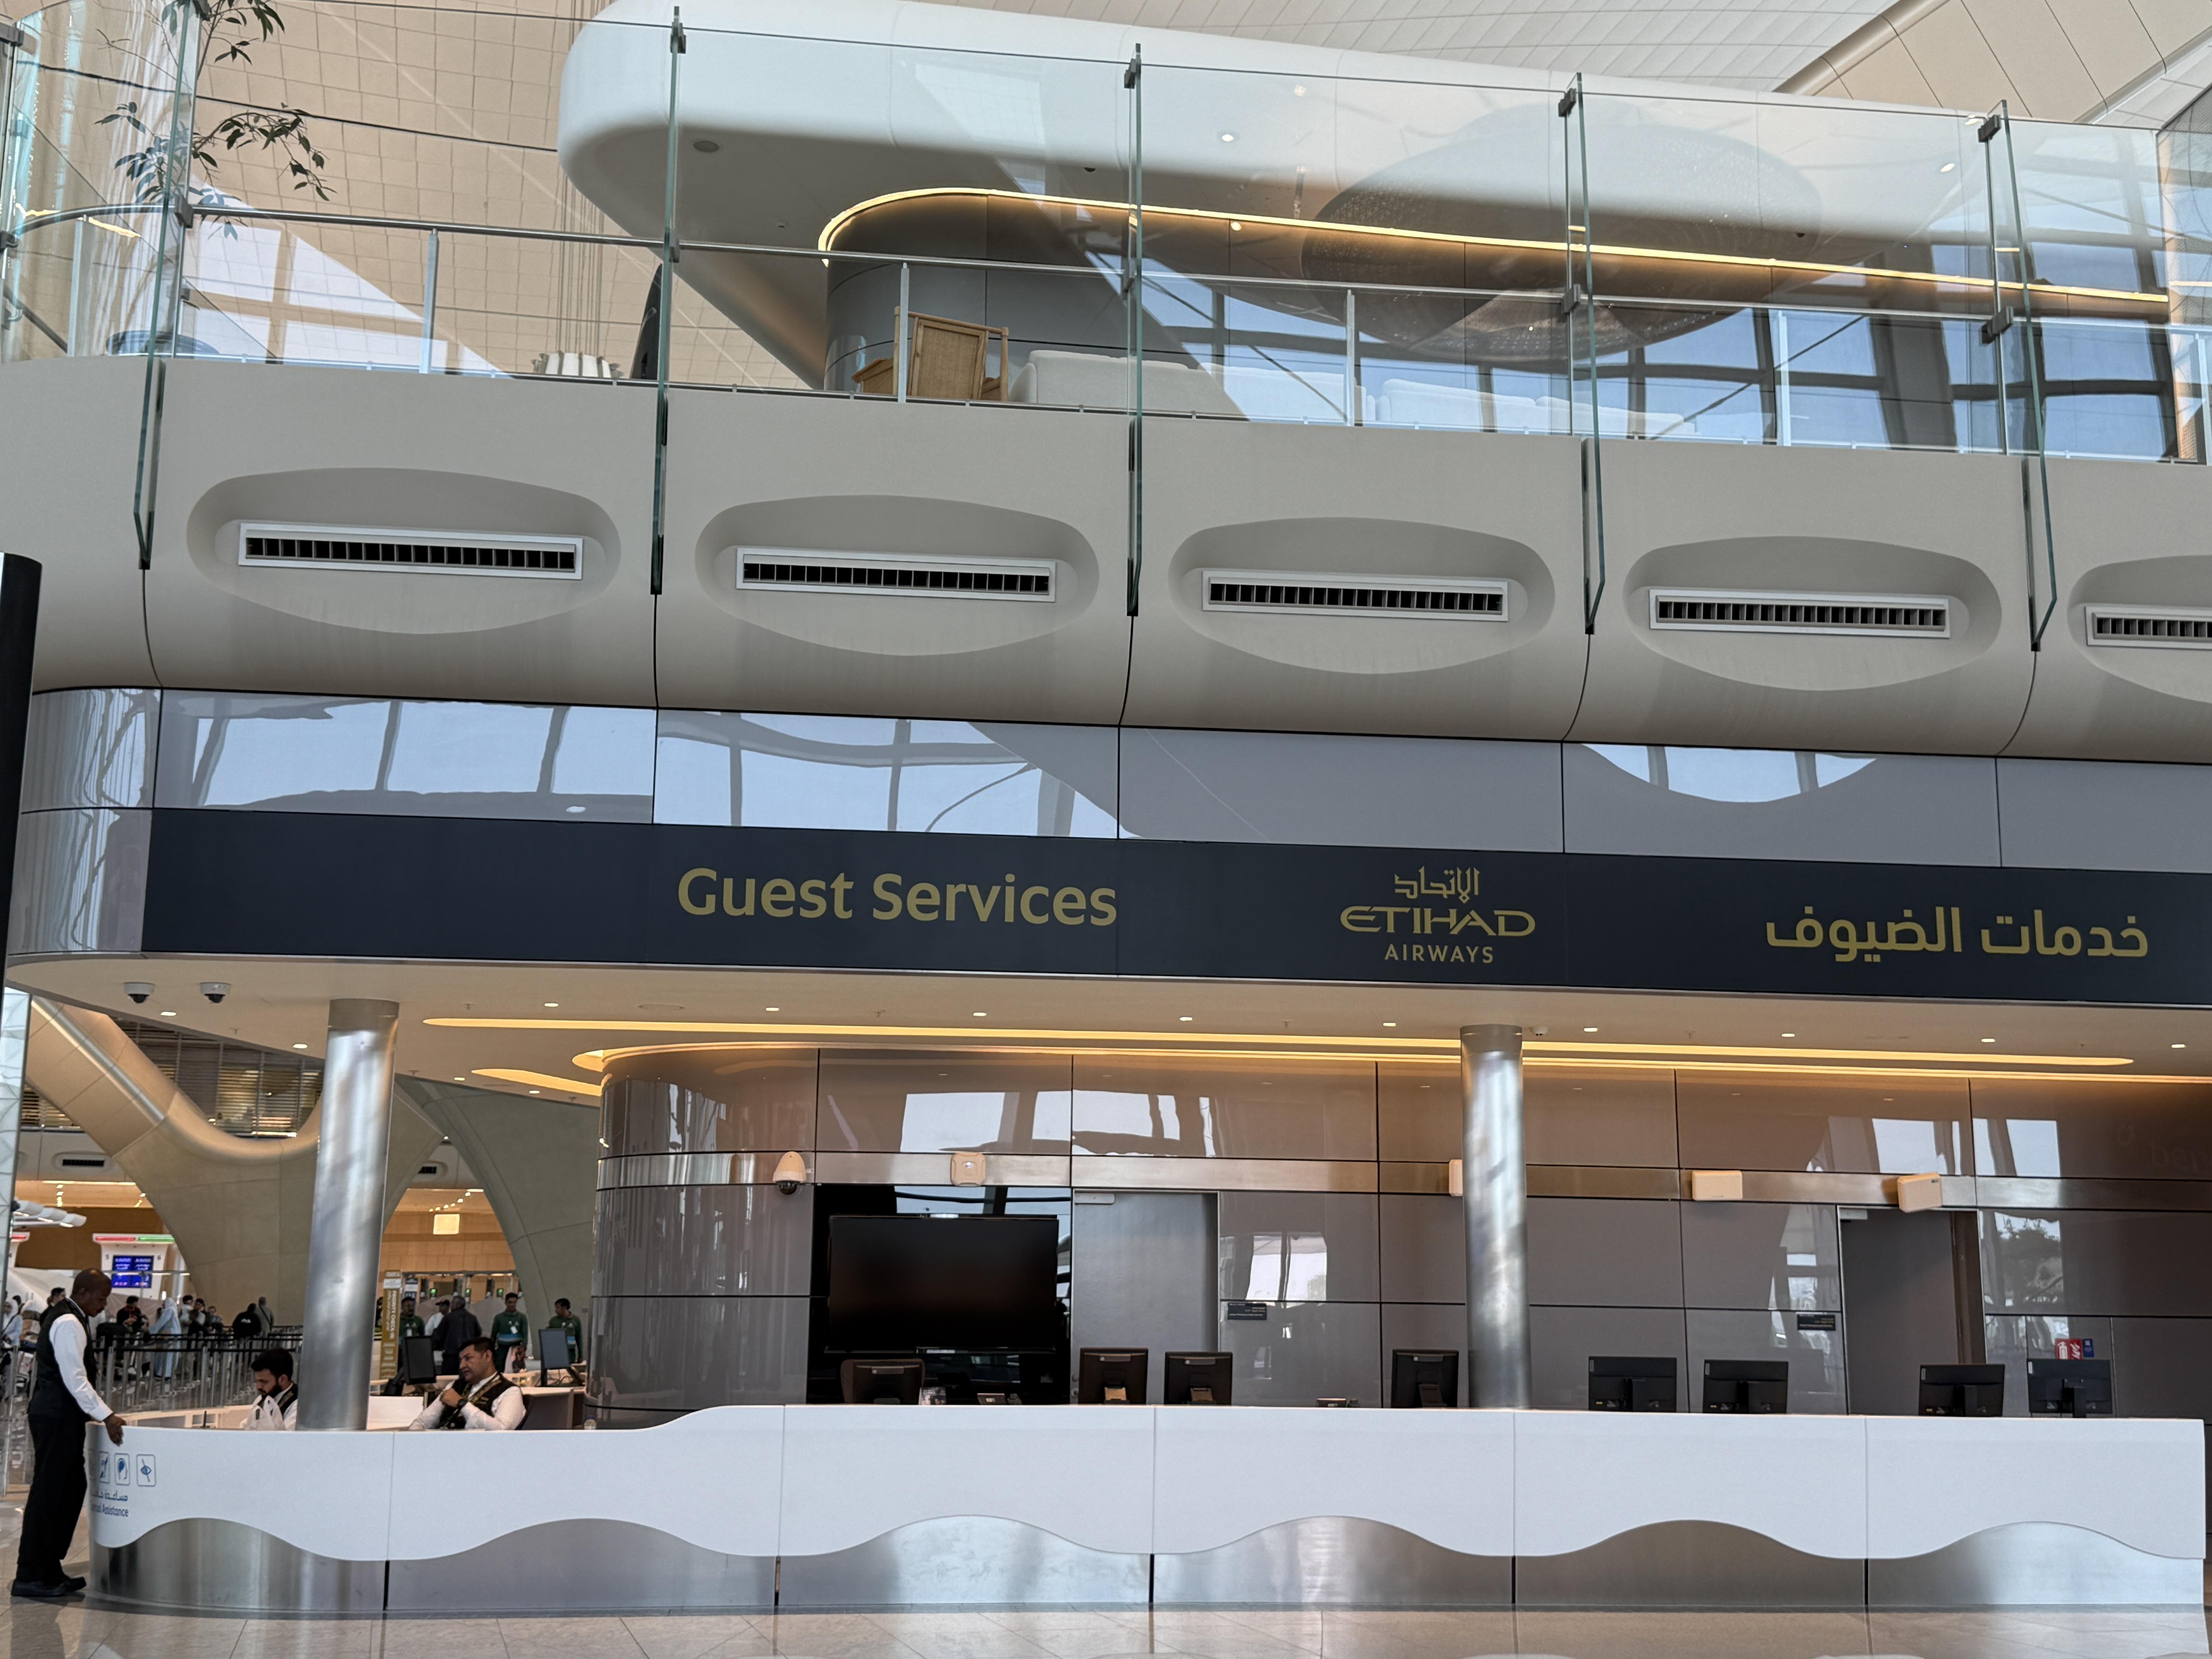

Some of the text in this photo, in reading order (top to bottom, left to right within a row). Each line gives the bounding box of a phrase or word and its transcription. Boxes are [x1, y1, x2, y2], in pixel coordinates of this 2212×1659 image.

[678, 868, 1117, 926] Guest Services
[1340, 905, 1535, 936] ETIHAD
[1766, 906, 2148, 962] خدمات الضيوف
[1384, 944, 1493, 963] AIRWAYS
